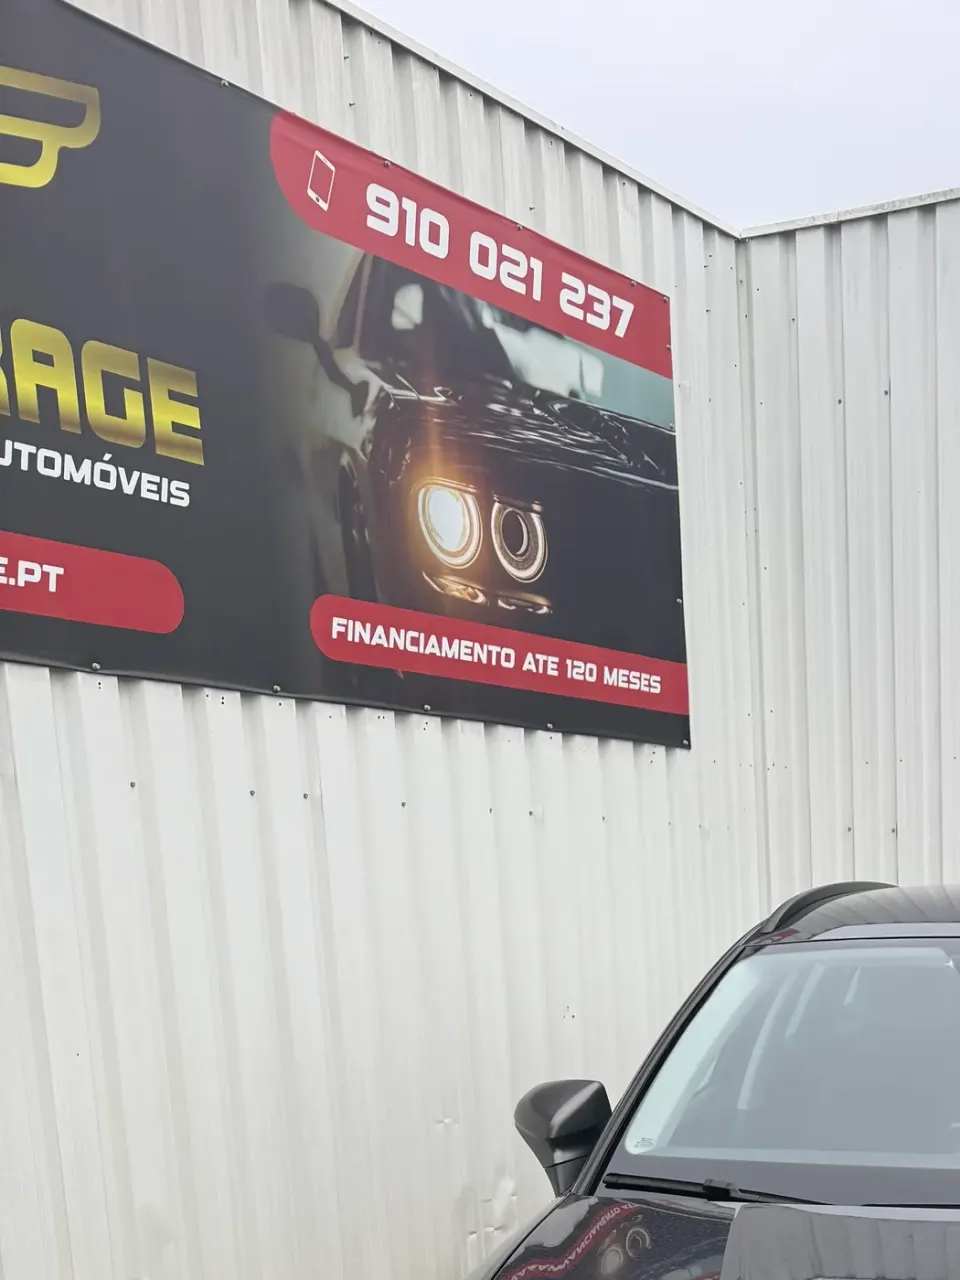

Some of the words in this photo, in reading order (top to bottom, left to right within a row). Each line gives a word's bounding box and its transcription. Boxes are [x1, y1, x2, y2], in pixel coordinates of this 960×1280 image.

[366, 183, 449, 259] 910
[469, 231, 543, 301] 021
[559, 272, 634, 338] 237
[0, 318, 204, 466] AGE
[331, 617, 515, 669] FINANCIAMENTO
[522, 652, 559, 676] ATE
[566, 659, 597, 683] 120
[603, 666, 661, 694] MESES
